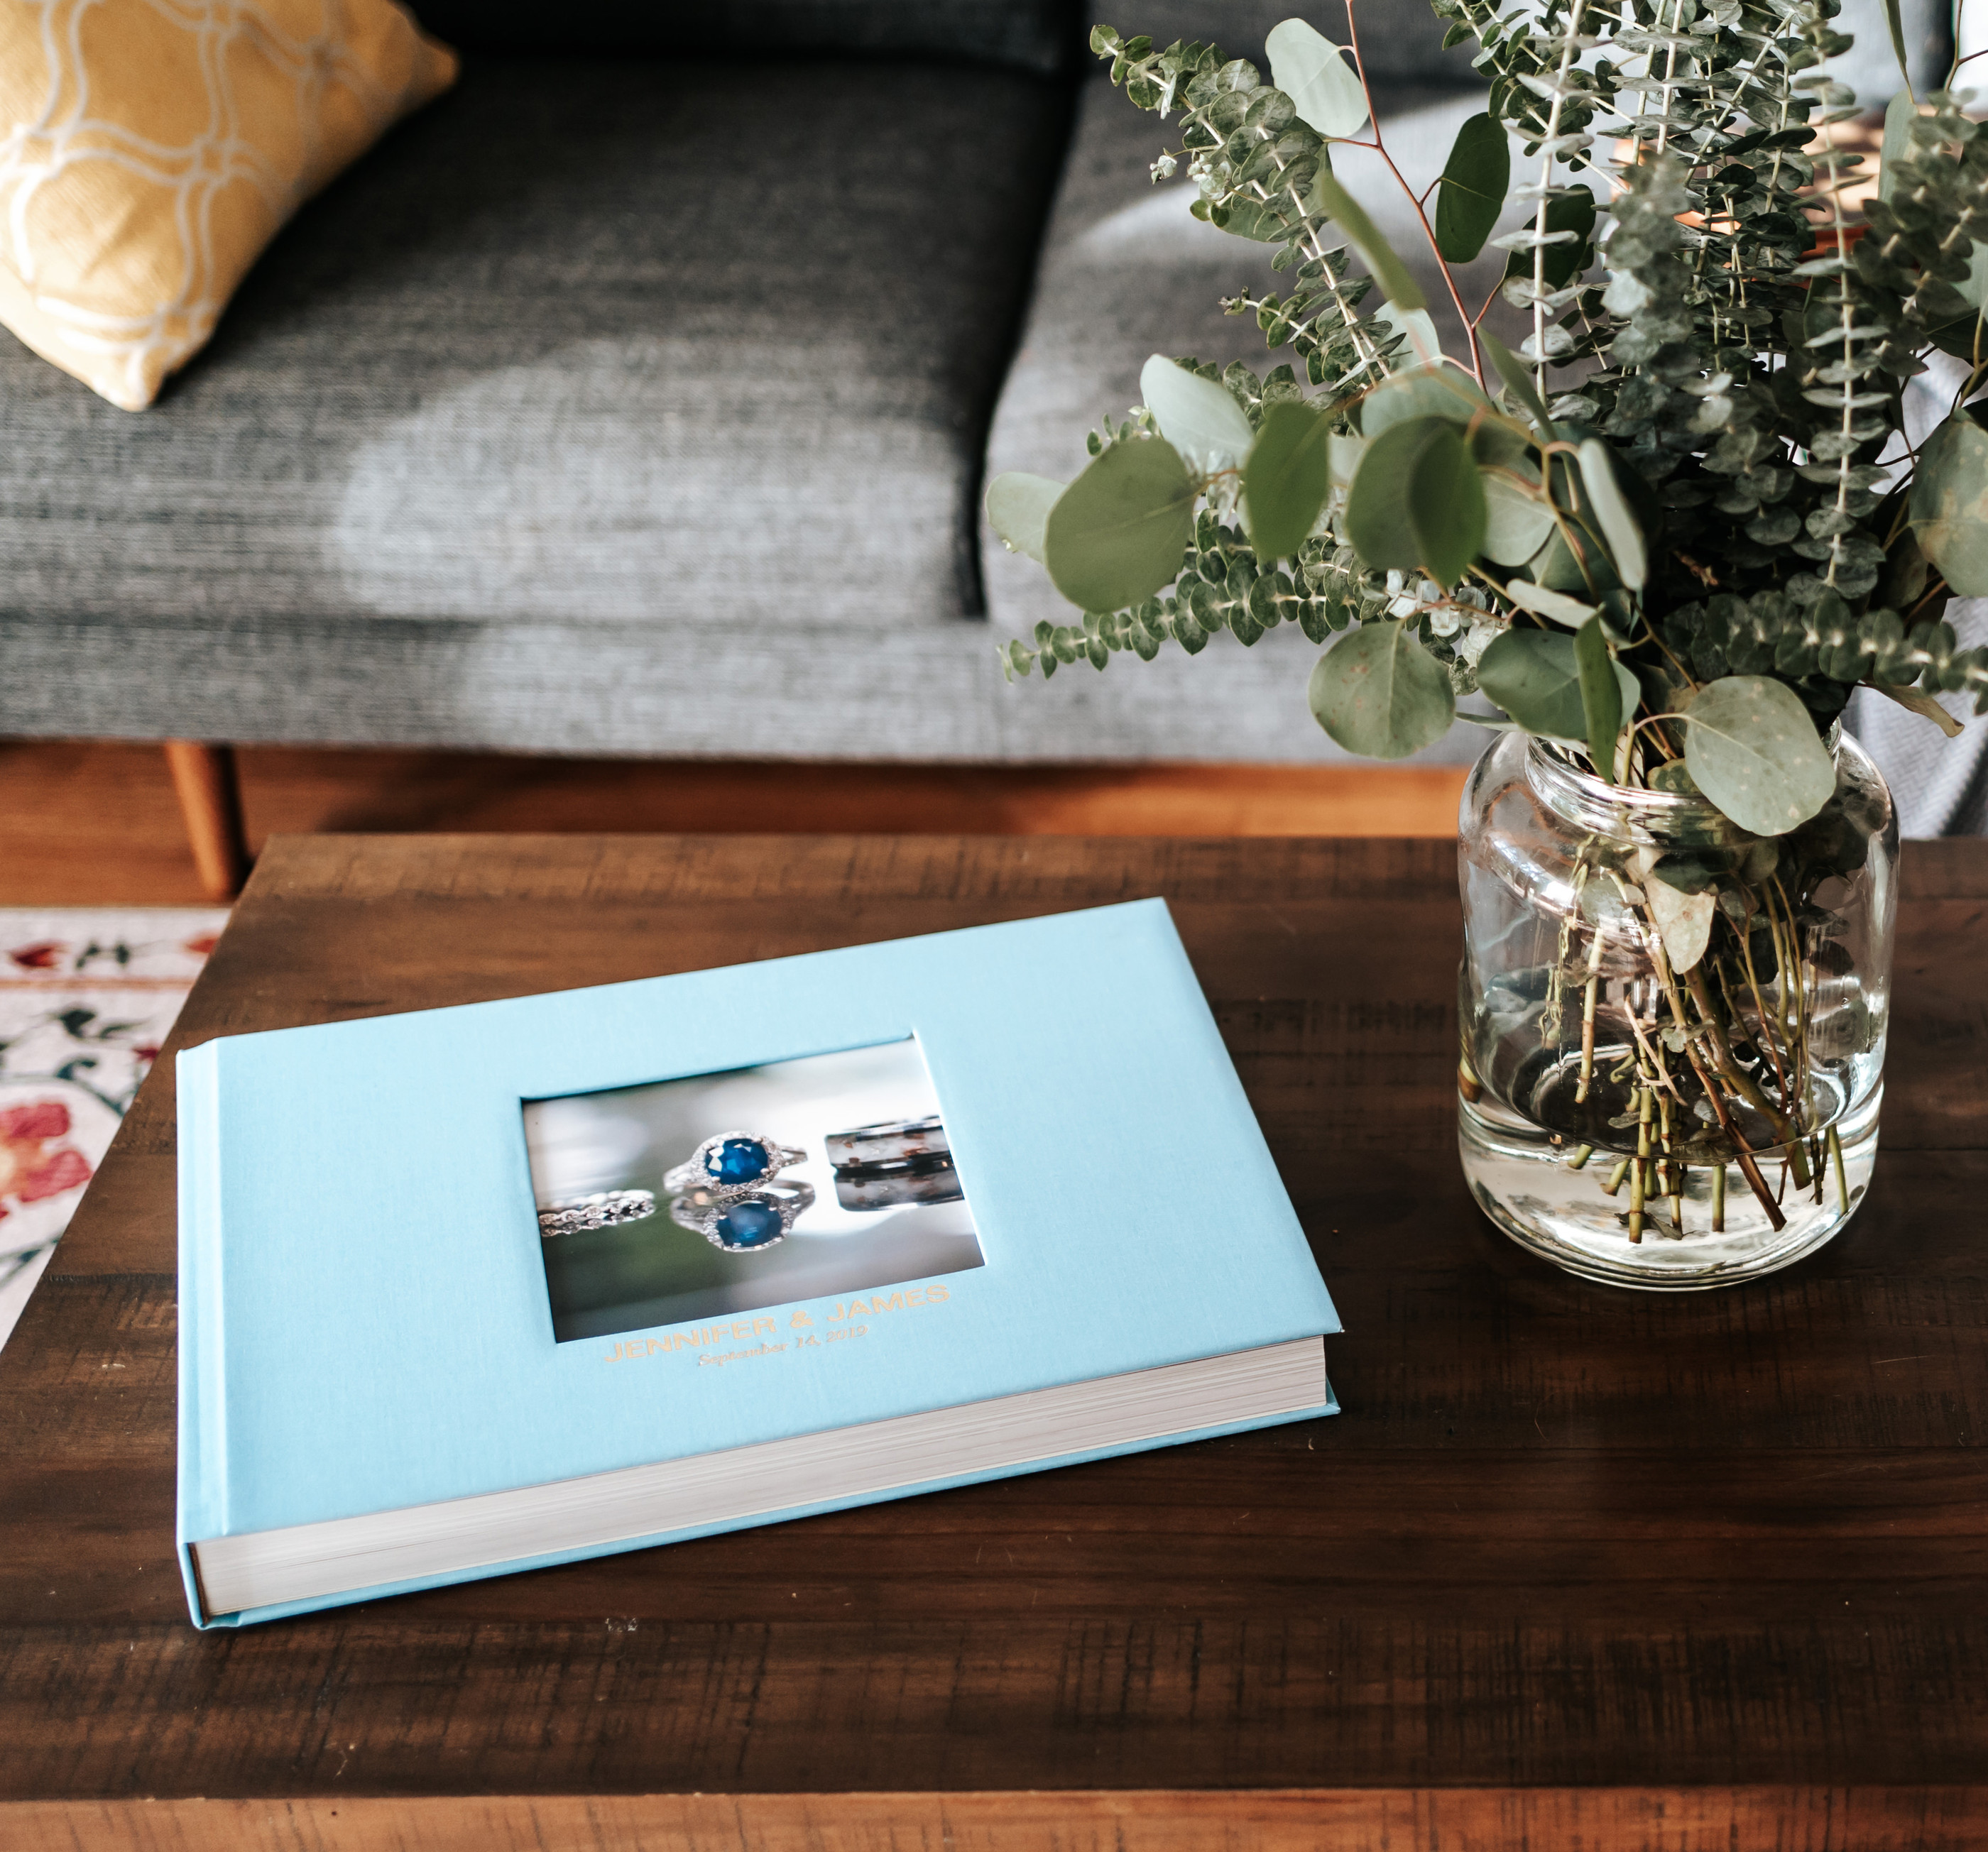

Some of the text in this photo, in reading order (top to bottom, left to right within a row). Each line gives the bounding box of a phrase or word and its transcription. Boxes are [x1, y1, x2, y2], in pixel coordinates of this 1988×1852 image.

[604, 1283, 951, 1363] JENNIFER & JAMES
[698, 1341, 790, 1367] September
[826, 1325, 869, 1343] 2019
